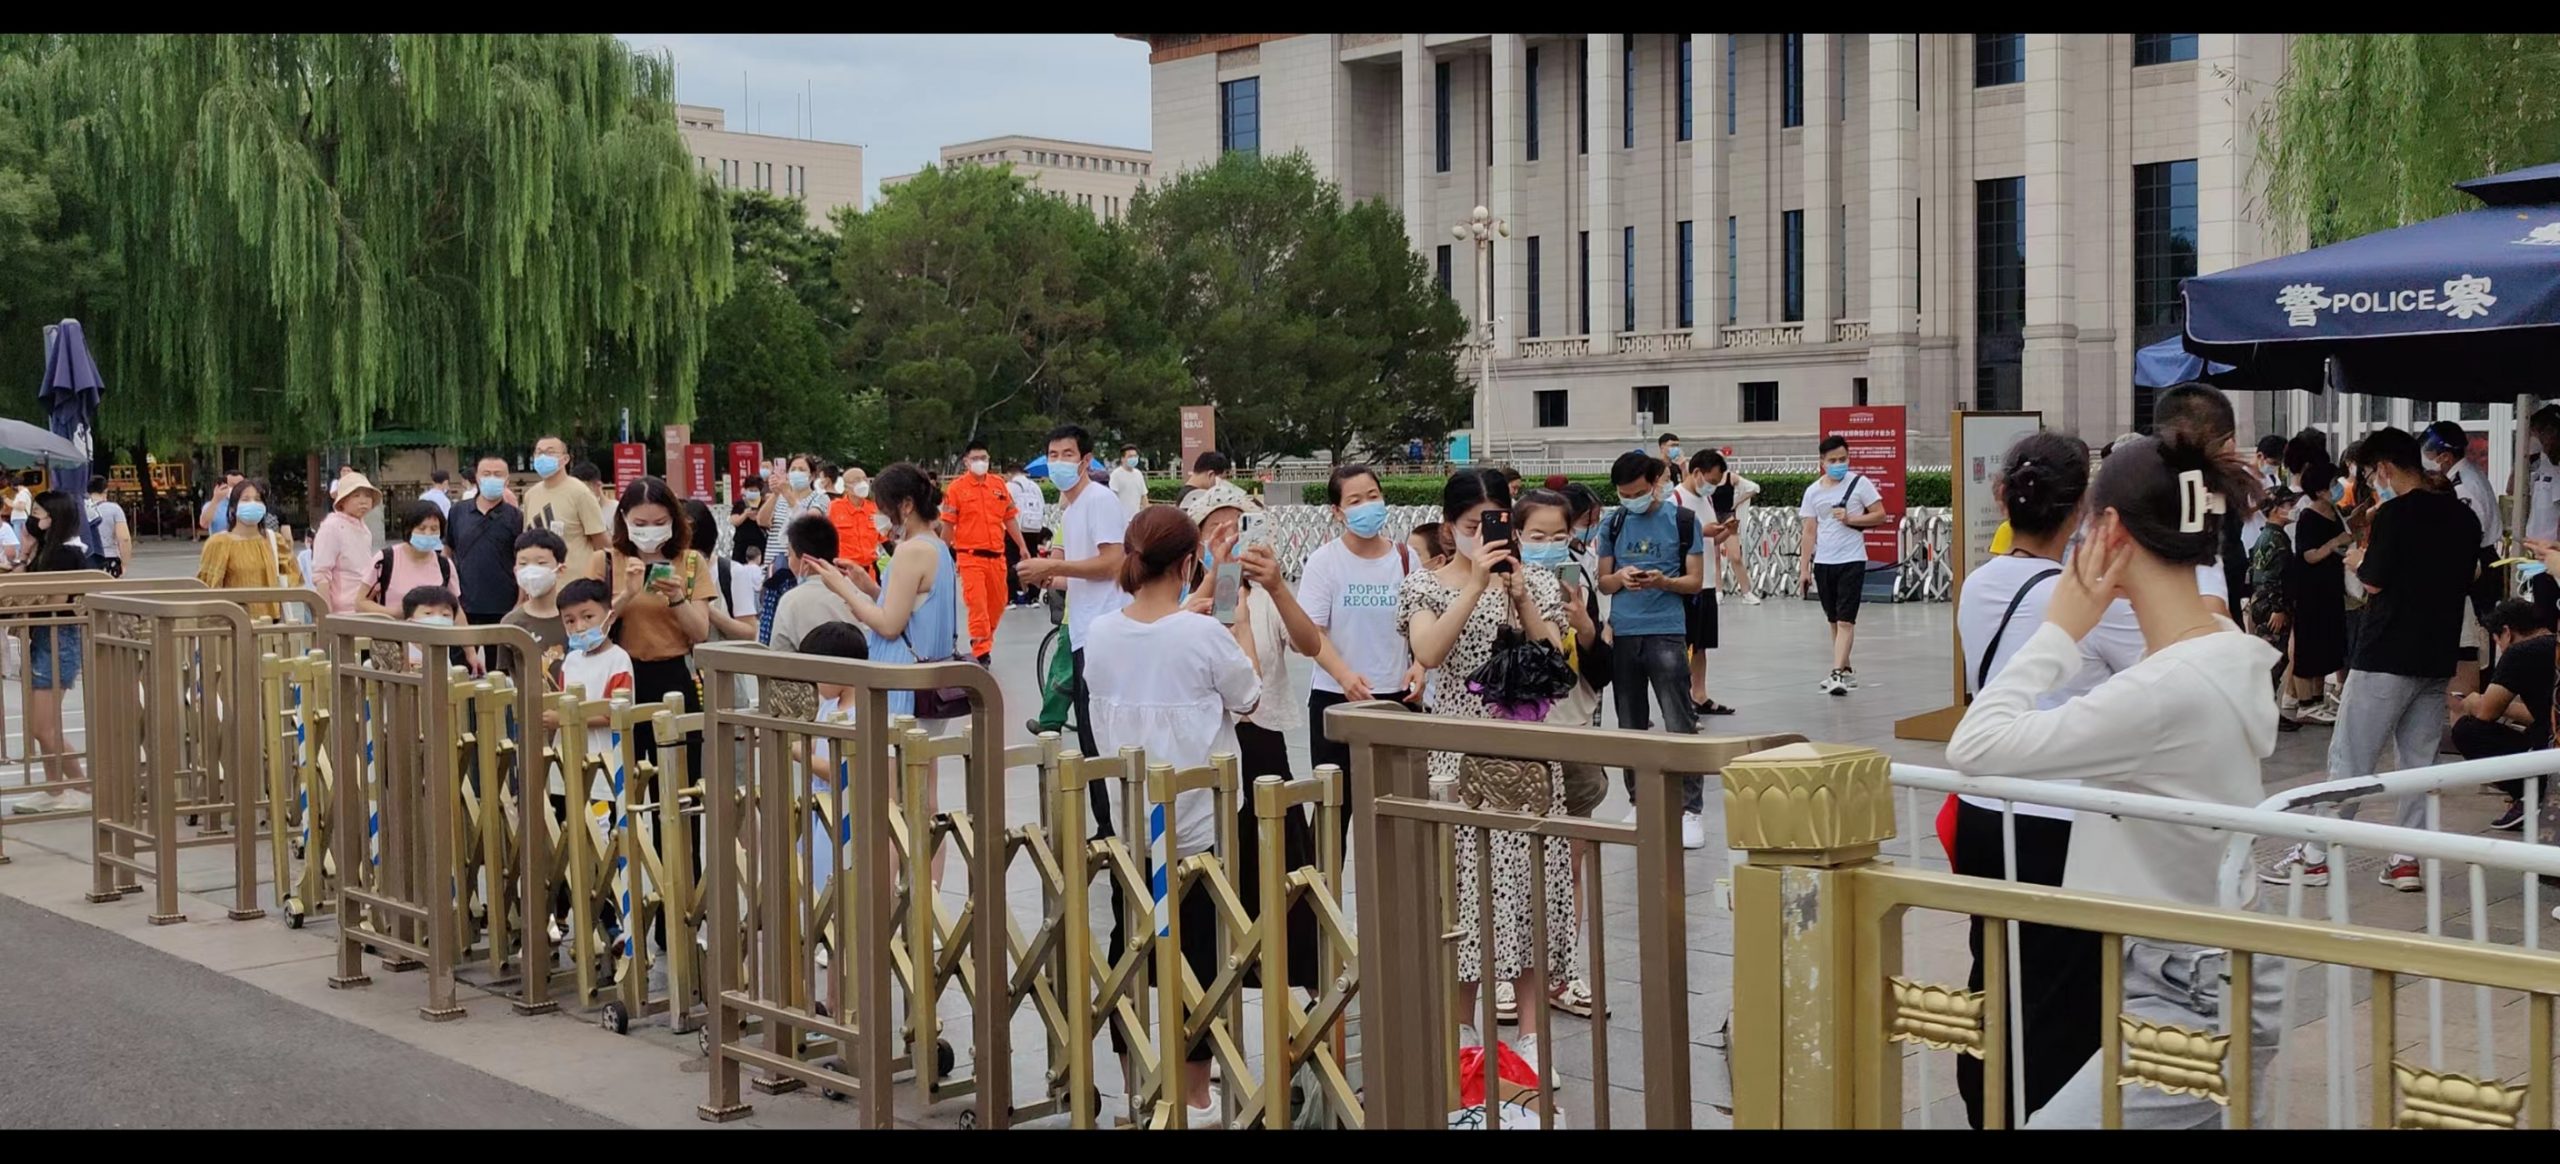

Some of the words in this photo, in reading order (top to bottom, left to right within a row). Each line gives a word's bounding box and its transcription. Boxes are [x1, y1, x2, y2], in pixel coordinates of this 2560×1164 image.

[2275, 282, 2332, 327] 警
[2332, 289, 2436, 314] POLICE
[2437, 273, 2497, 319] 察
[1348, 583, 1390, 595] POPUP
[1343, 595, 1398, 607] RECORD
